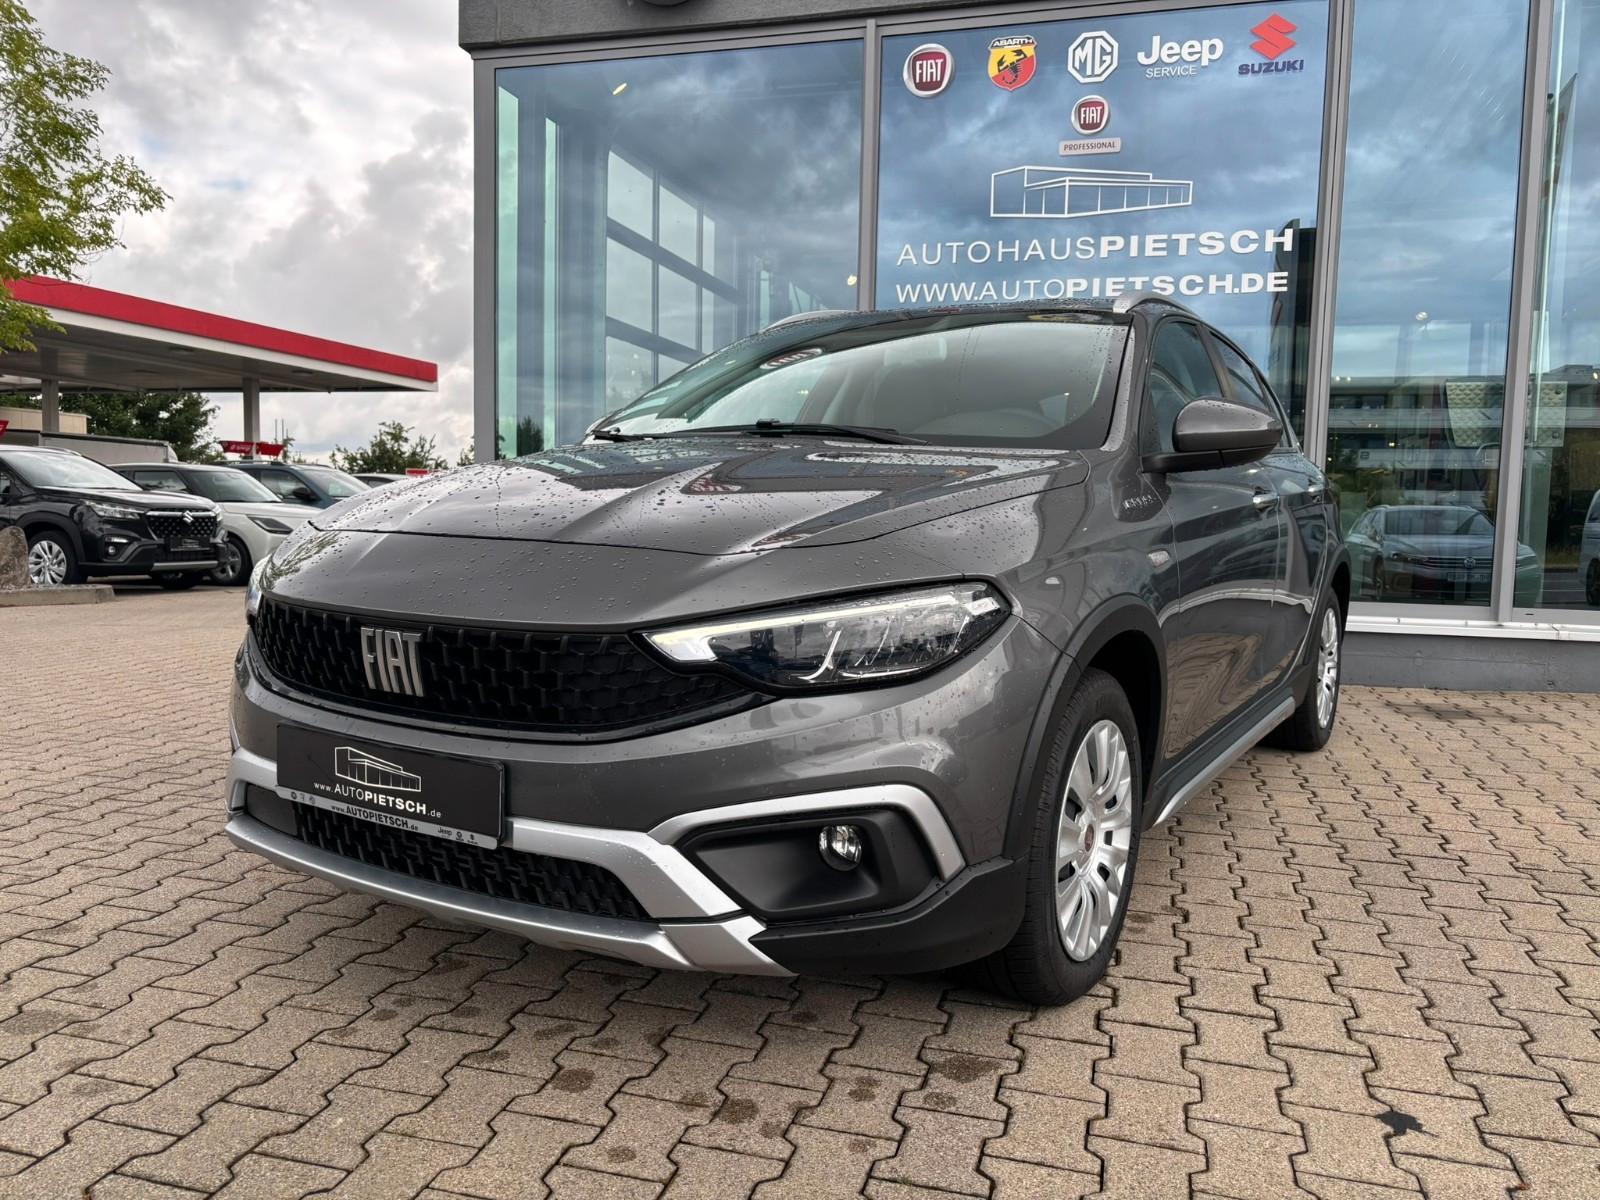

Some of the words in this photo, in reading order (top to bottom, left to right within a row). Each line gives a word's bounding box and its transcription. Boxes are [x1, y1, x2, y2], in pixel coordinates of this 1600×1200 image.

[993, 37, 1033, 47] ABARTH
[1137, 35, 1224, 66] Jeep
[1074, 37, 1113, 76] MG
[1238, 59, 1305, 76] SUZUKI
[916, 59, 944, 83] FIAT
[1145, 65, 1198, 78] SERVICE
[1080, 105, 1103, 125] FIAT
[1063, 141, 1116, 152] PROFESSIONAL
[896, 228, 1294, 266] AUTOHAUSPIETSCH
[896, 271, 1289, 303] WWW.AUTOPIETSCH.DE
[360, 627, 424, 698] FIAT
